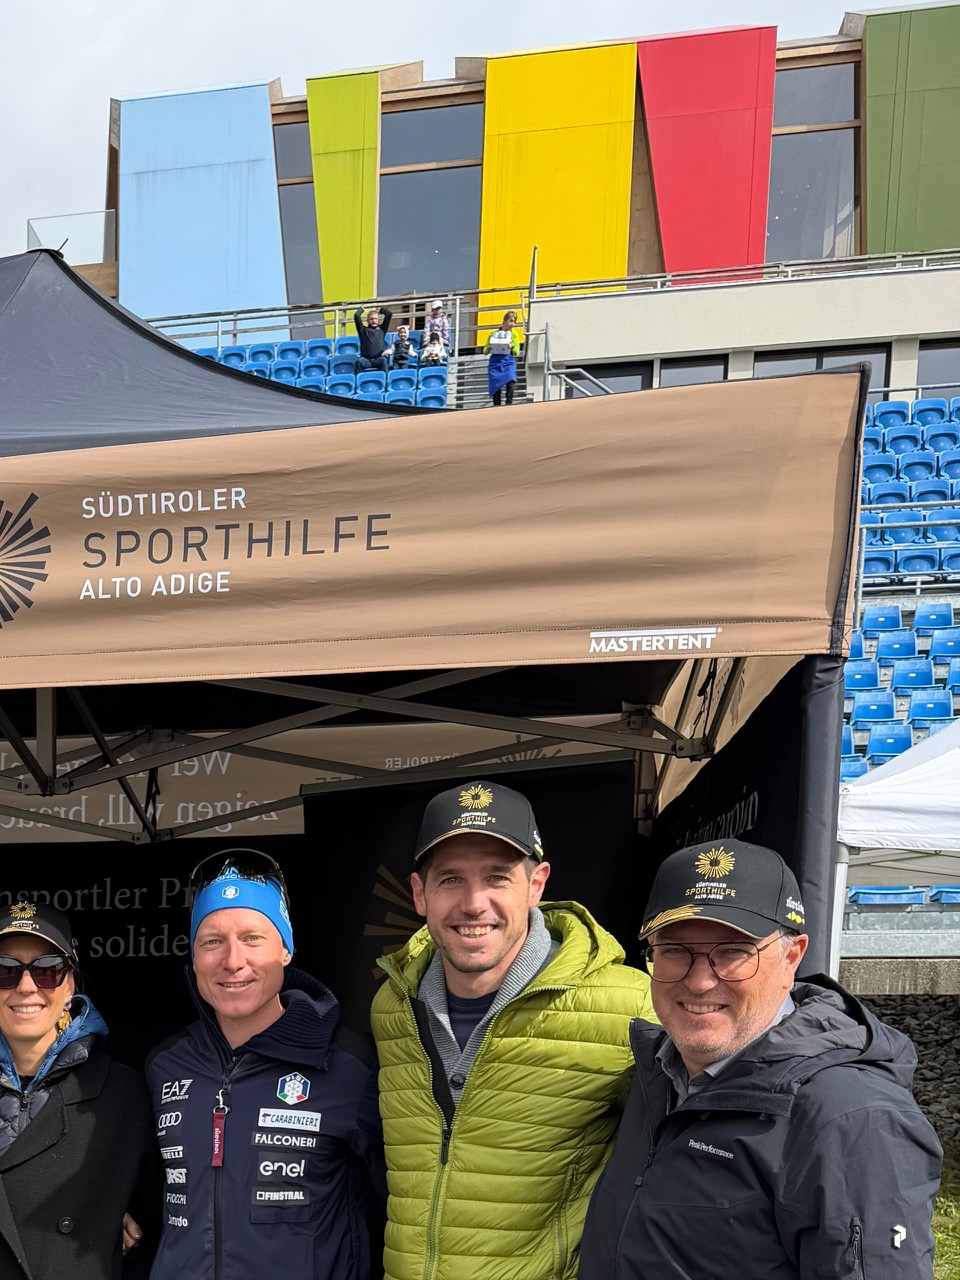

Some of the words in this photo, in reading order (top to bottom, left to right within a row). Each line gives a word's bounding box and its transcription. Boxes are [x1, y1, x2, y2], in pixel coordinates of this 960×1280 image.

[82, 487, 246, 519] SÜDTIROLER
[83, 513, 392, 567] SPORTHILFE
[79, 576, 142, 600] ALTO
[151, 571, 231, 596] ADIGE
[588, 633, 717, 654] MASTERTENT
[685, 887, 737, 897] SPORTHILFE
[90, 924, 189, 959] solide
[161, 1079, 193, 1100] EA7
[270, 1114, 319, 1127] CARABINIERI
[255, 1133, 317, 1148] FALCONERI
[259, 1159, 306, 1178] enel
